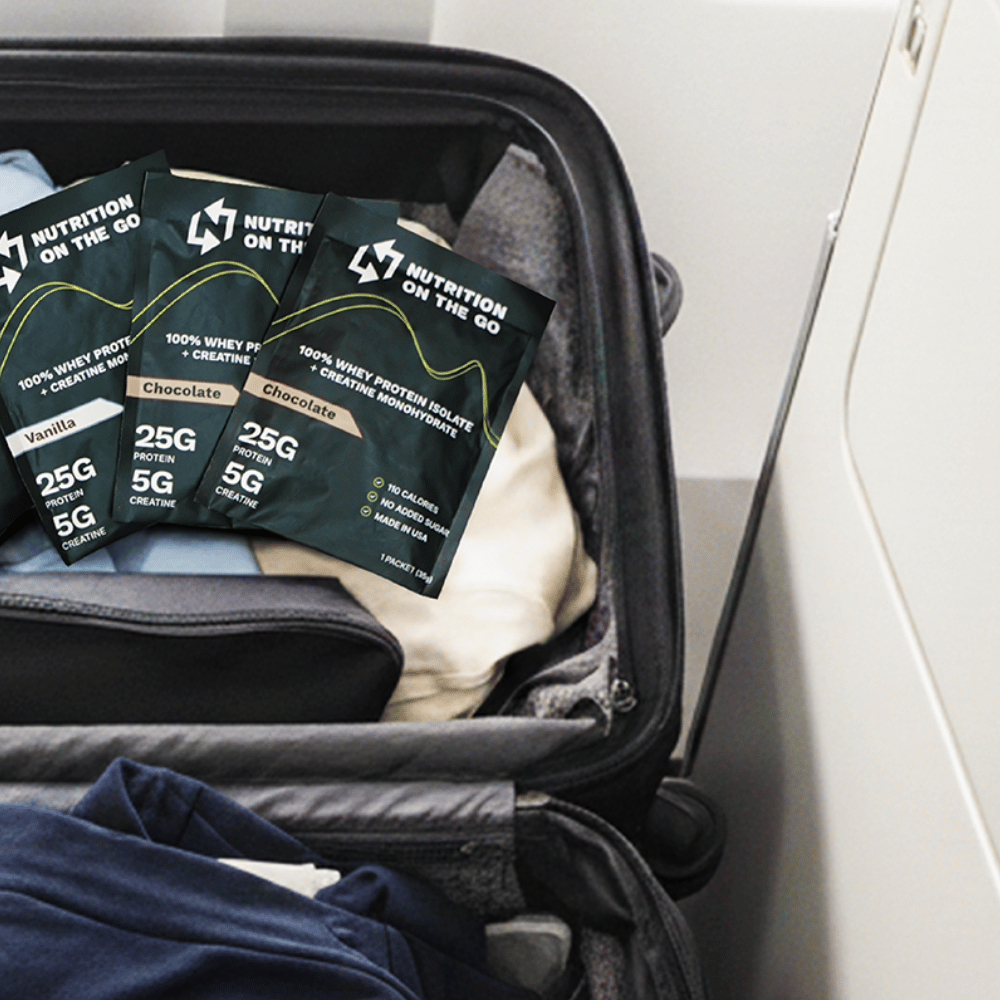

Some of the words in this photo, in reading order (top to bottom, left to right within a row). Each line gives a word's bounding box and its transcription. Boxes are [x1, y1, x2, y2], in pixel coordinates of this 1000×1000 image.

[30, 194, 135, 248] NUTRITION
[39, 244, 70, 264] ON
[68, 228, 110, 256] THE
[113, 212, 140, 234] GO
[244, 234, 272, 250] ON
[278, 238, 307, 254] TH
[406, 262, 508, 320] NUTRITION
[401, 280, 434, 306] ON
[433, 293, 470, 321] THE
[474, 311, 502, 336] GO
[166, 333, 200, 346] 100%
[204, 336, 244, 351] WHEY
[18, 370, 54, 390] 100%
[53, 352, 92, 376] WHEY
[192, 350, 252, 366] CREATINE
[50, 362, 106, 393] CREATINE
[142, 382, 222, 400] Chocolate
[298, 344, 334, 366] 100%
[334, 357, 374, 384] WHEY
[374, 374, 427, 406] PROTEIN
[428, 396, 475, 434] ISOLATE
[262, 384, 337, 421] Chocolate
[319, 367, 376, 403] CREATINE
[376, 388, 458, 440] MONOHYDRATE
[24, 416, 77, 445] Vanilla
[134, 424, 197, 452] 25G
[236, 421, 299, 462] 25G
[134, 452, 175, 464] PROTEIN
[232, 445, 272, 466] PROTEIN
[35, 456, 97, 497] 25G
[132, 470, 174, 494] 5G
[222, 463, 265, 496] 5G
[45, 488, 84, 510] PROTEIN
[129, 496, 176, 508] CREATINE
[214, 485, 260, 510] CREATINE
[387, 484, 401, 496] 110
[400, 490, 440, 514] CALORIES
[52, 504, 97, 538] 5G
[374, 512, 401, 530] MADE
[400, 524, 412, 534] IN
[411, 529, 428, 542] USA
[380, 498, 395, 510] NO
[394, 504, 424, 524] ADDED
[424, 518, 450, 538] SUGAR
[61, 526, 106, 551] CREATINE
[385, 555, 415, 574] PACKET
